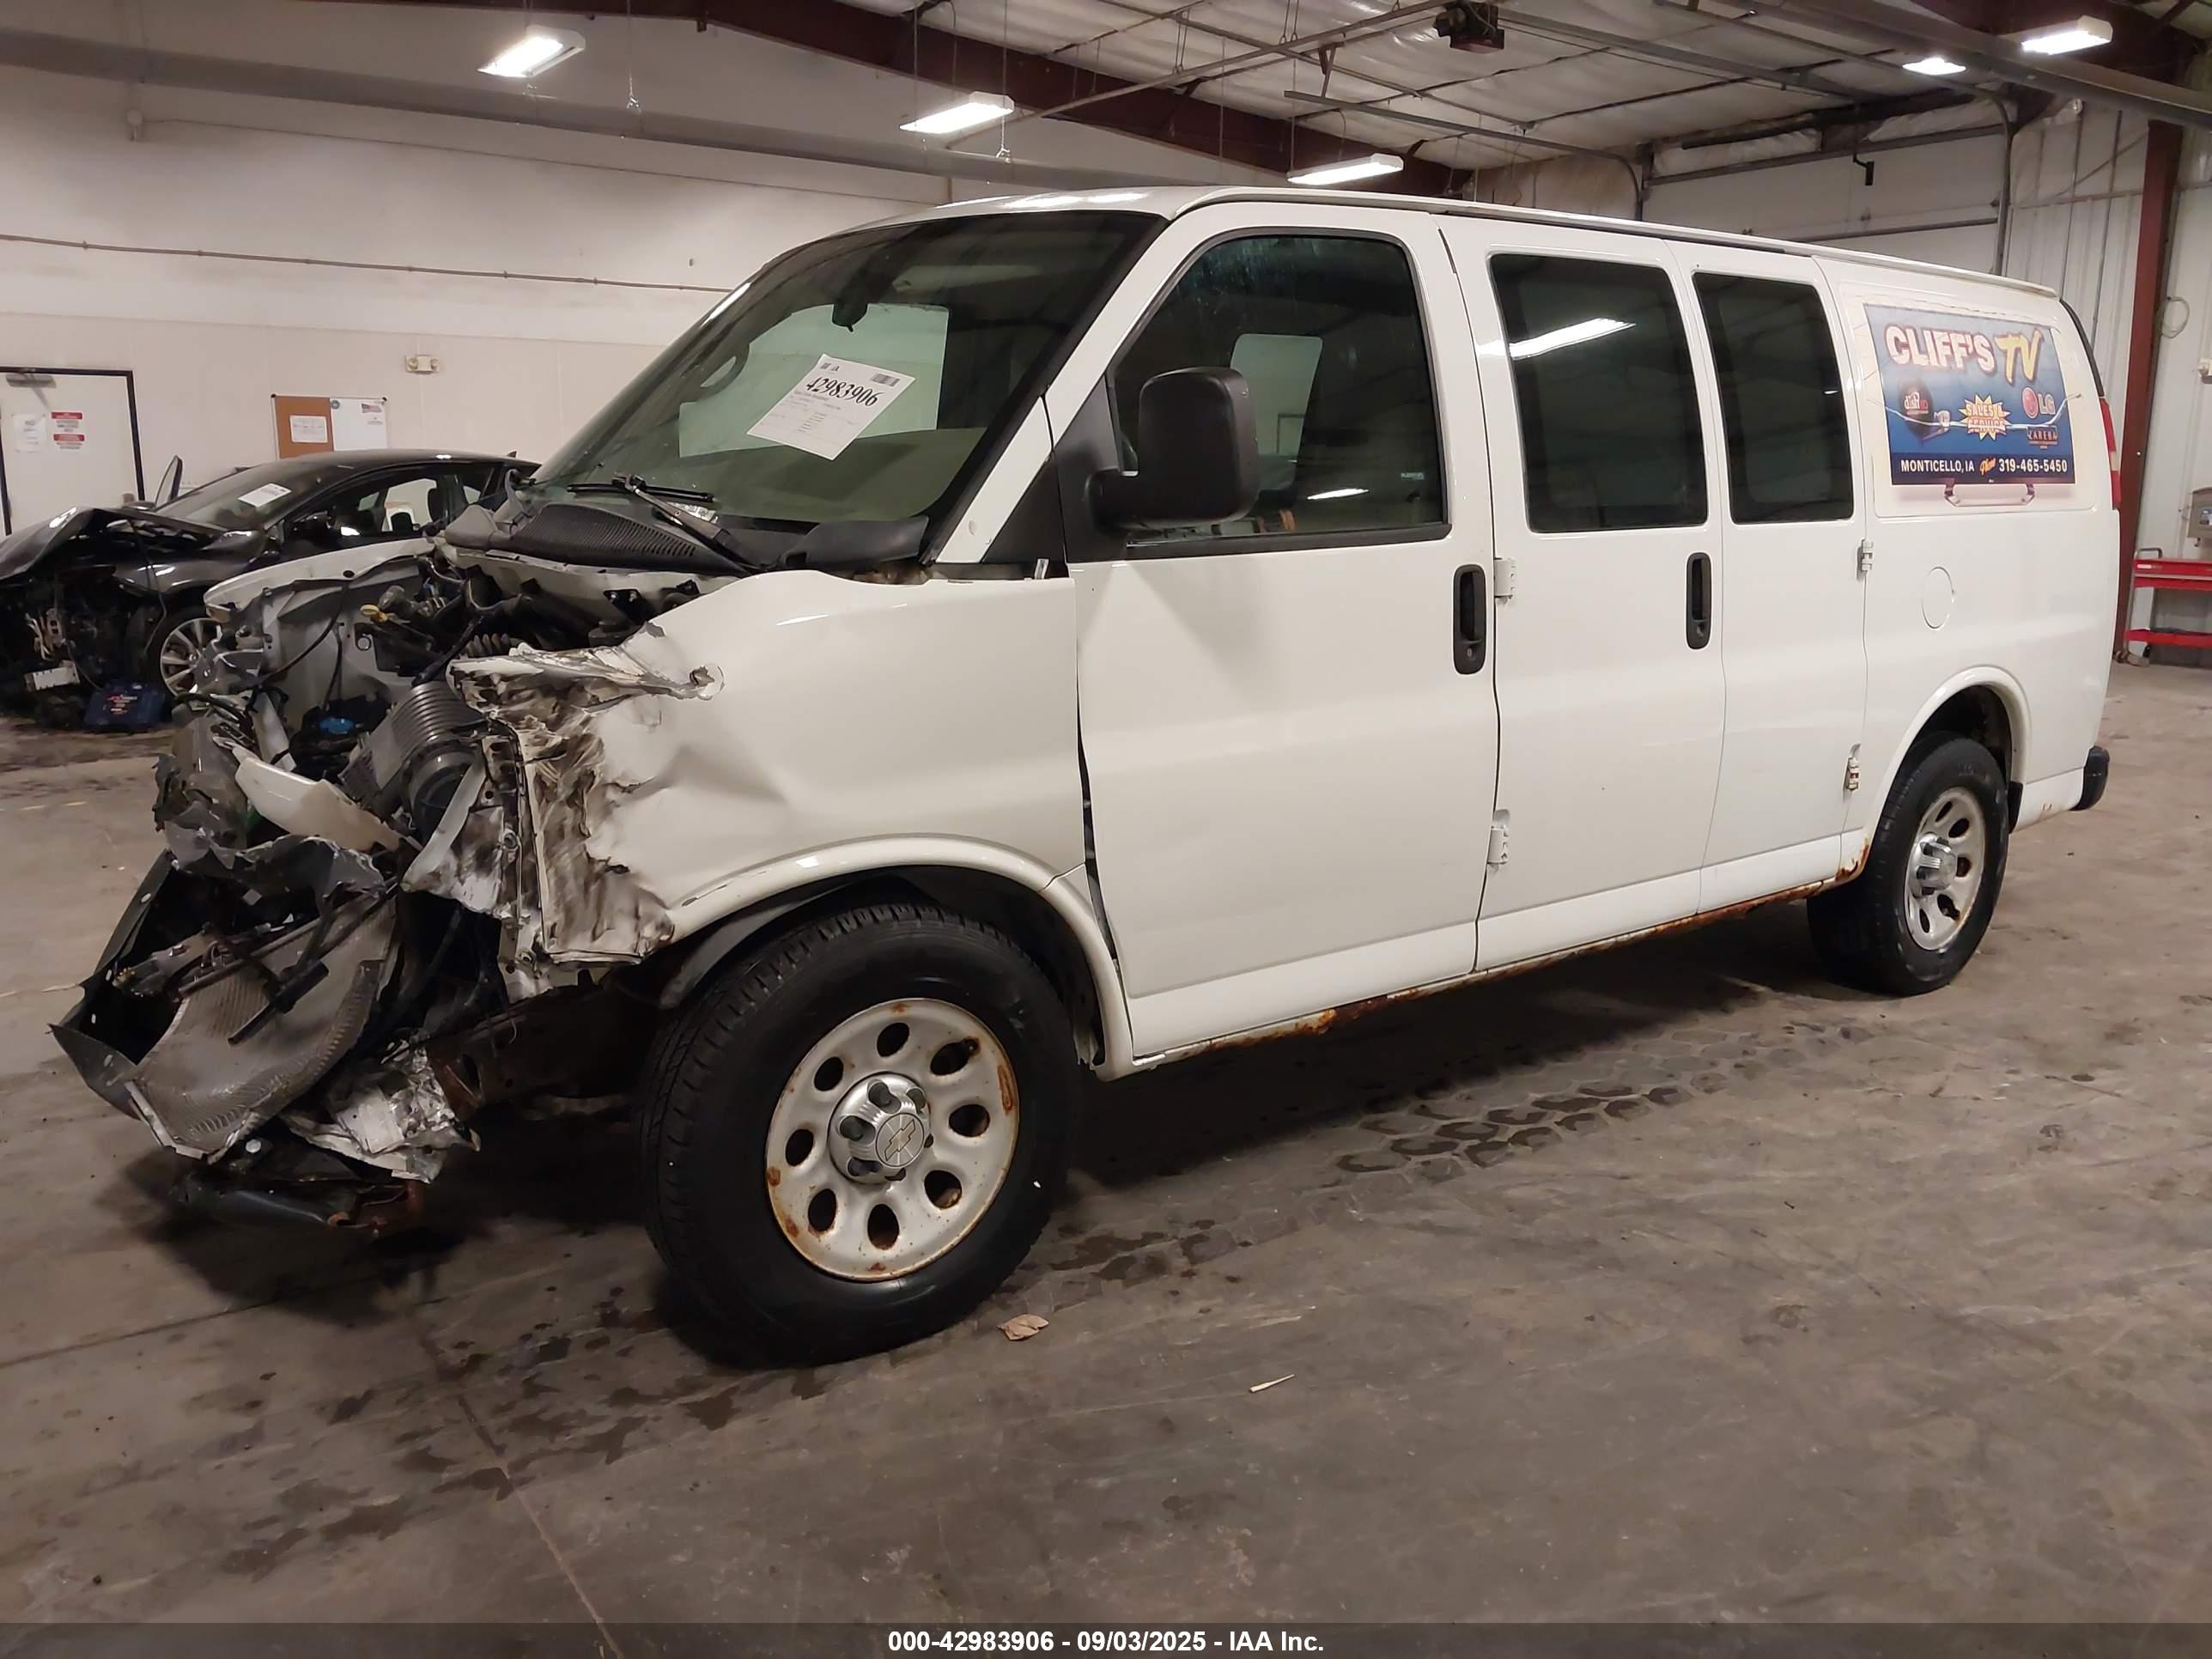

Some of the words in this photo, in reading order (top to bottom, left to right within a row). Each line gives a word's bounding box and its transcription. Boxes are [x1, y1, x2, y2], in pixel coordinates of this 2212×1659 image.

[1885, 325, 1996, 374] CLIFF'S
[1994, 328, 2043, 384] TV
[805, 376, 884, 406] 42983906
[1966, 404, 1994, 417] SALES
[2038, 393, 2056, 415] LG
[1998, 458, 2068, 473] 319-465-5450
